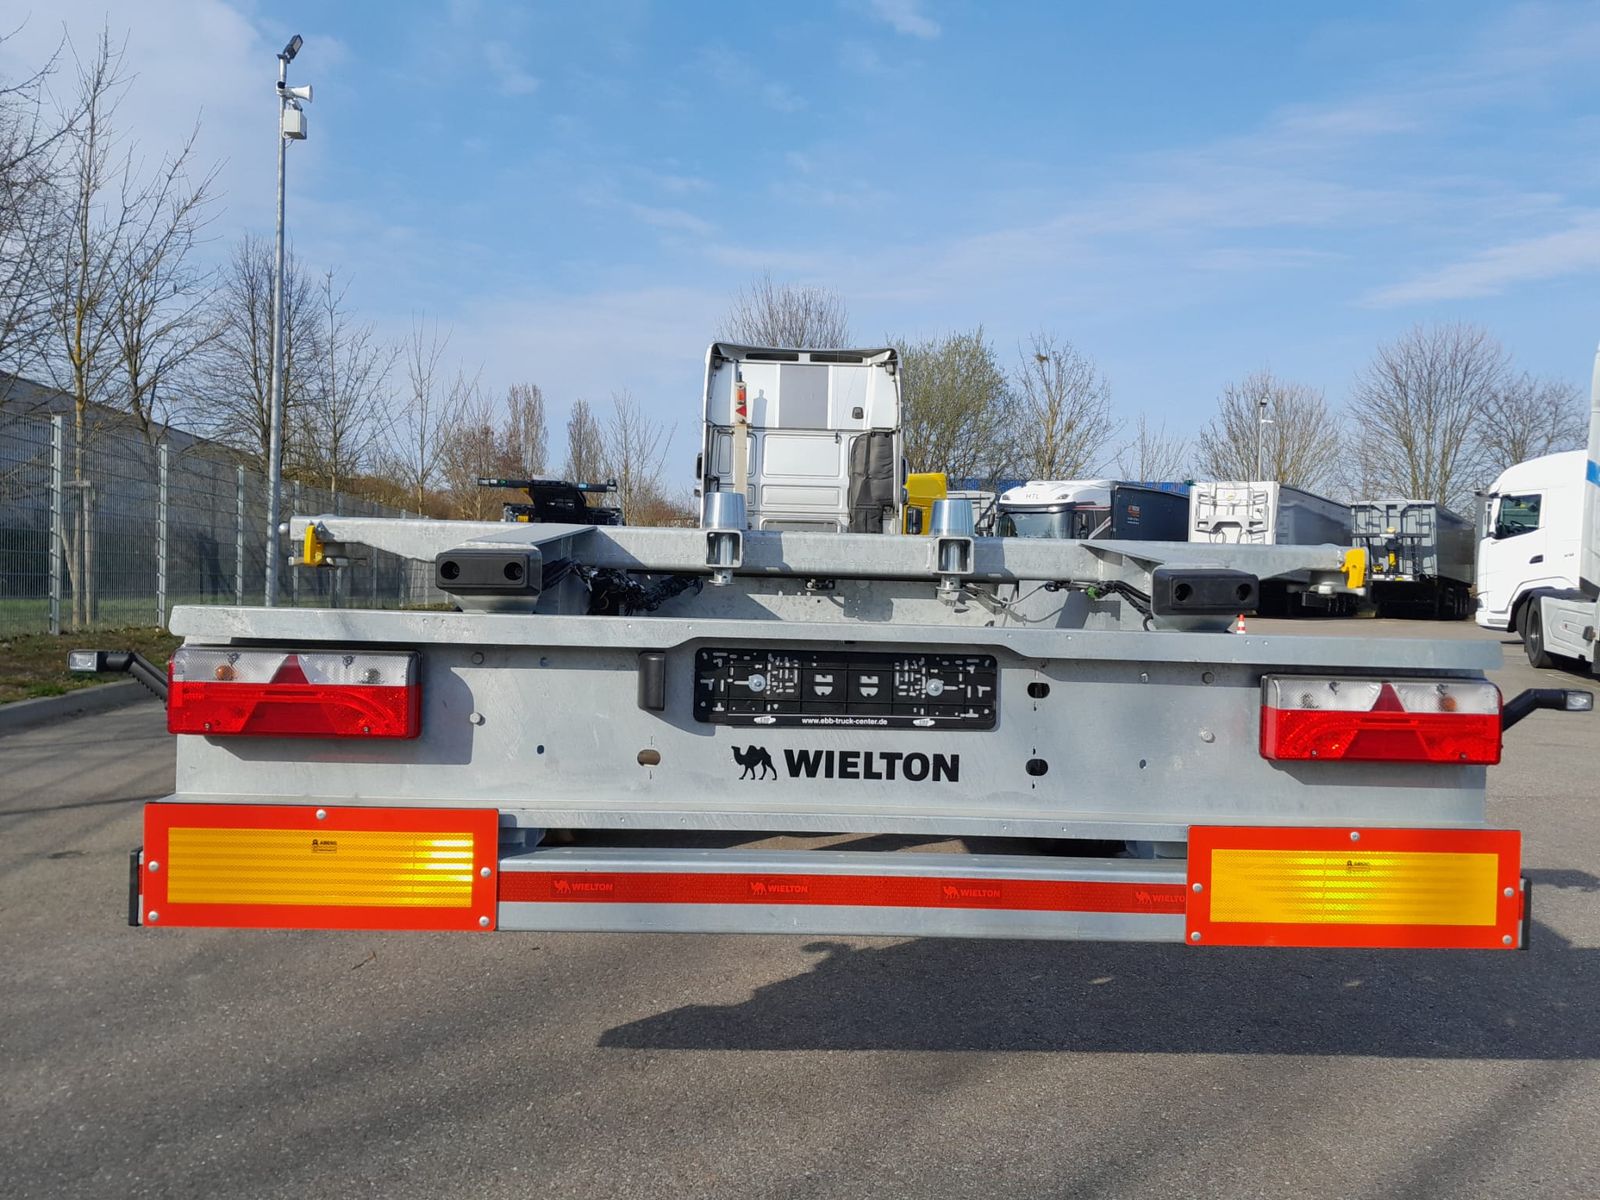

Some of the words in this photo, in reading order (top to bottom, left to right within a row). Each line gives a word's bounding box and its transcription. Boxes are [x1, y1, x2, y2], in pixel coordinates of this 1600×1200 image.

[801, 717, 888, 725] www.ebb-truck-center.de
[784, 749, 960, 782] WIELTON
[572, 883, 613, 891] WIELTON
[767, 884, 809, 893] WIELTON
[961, 889, 1000, 898] WIELTON
[1152, 894, 1186, 903] WIELTO
